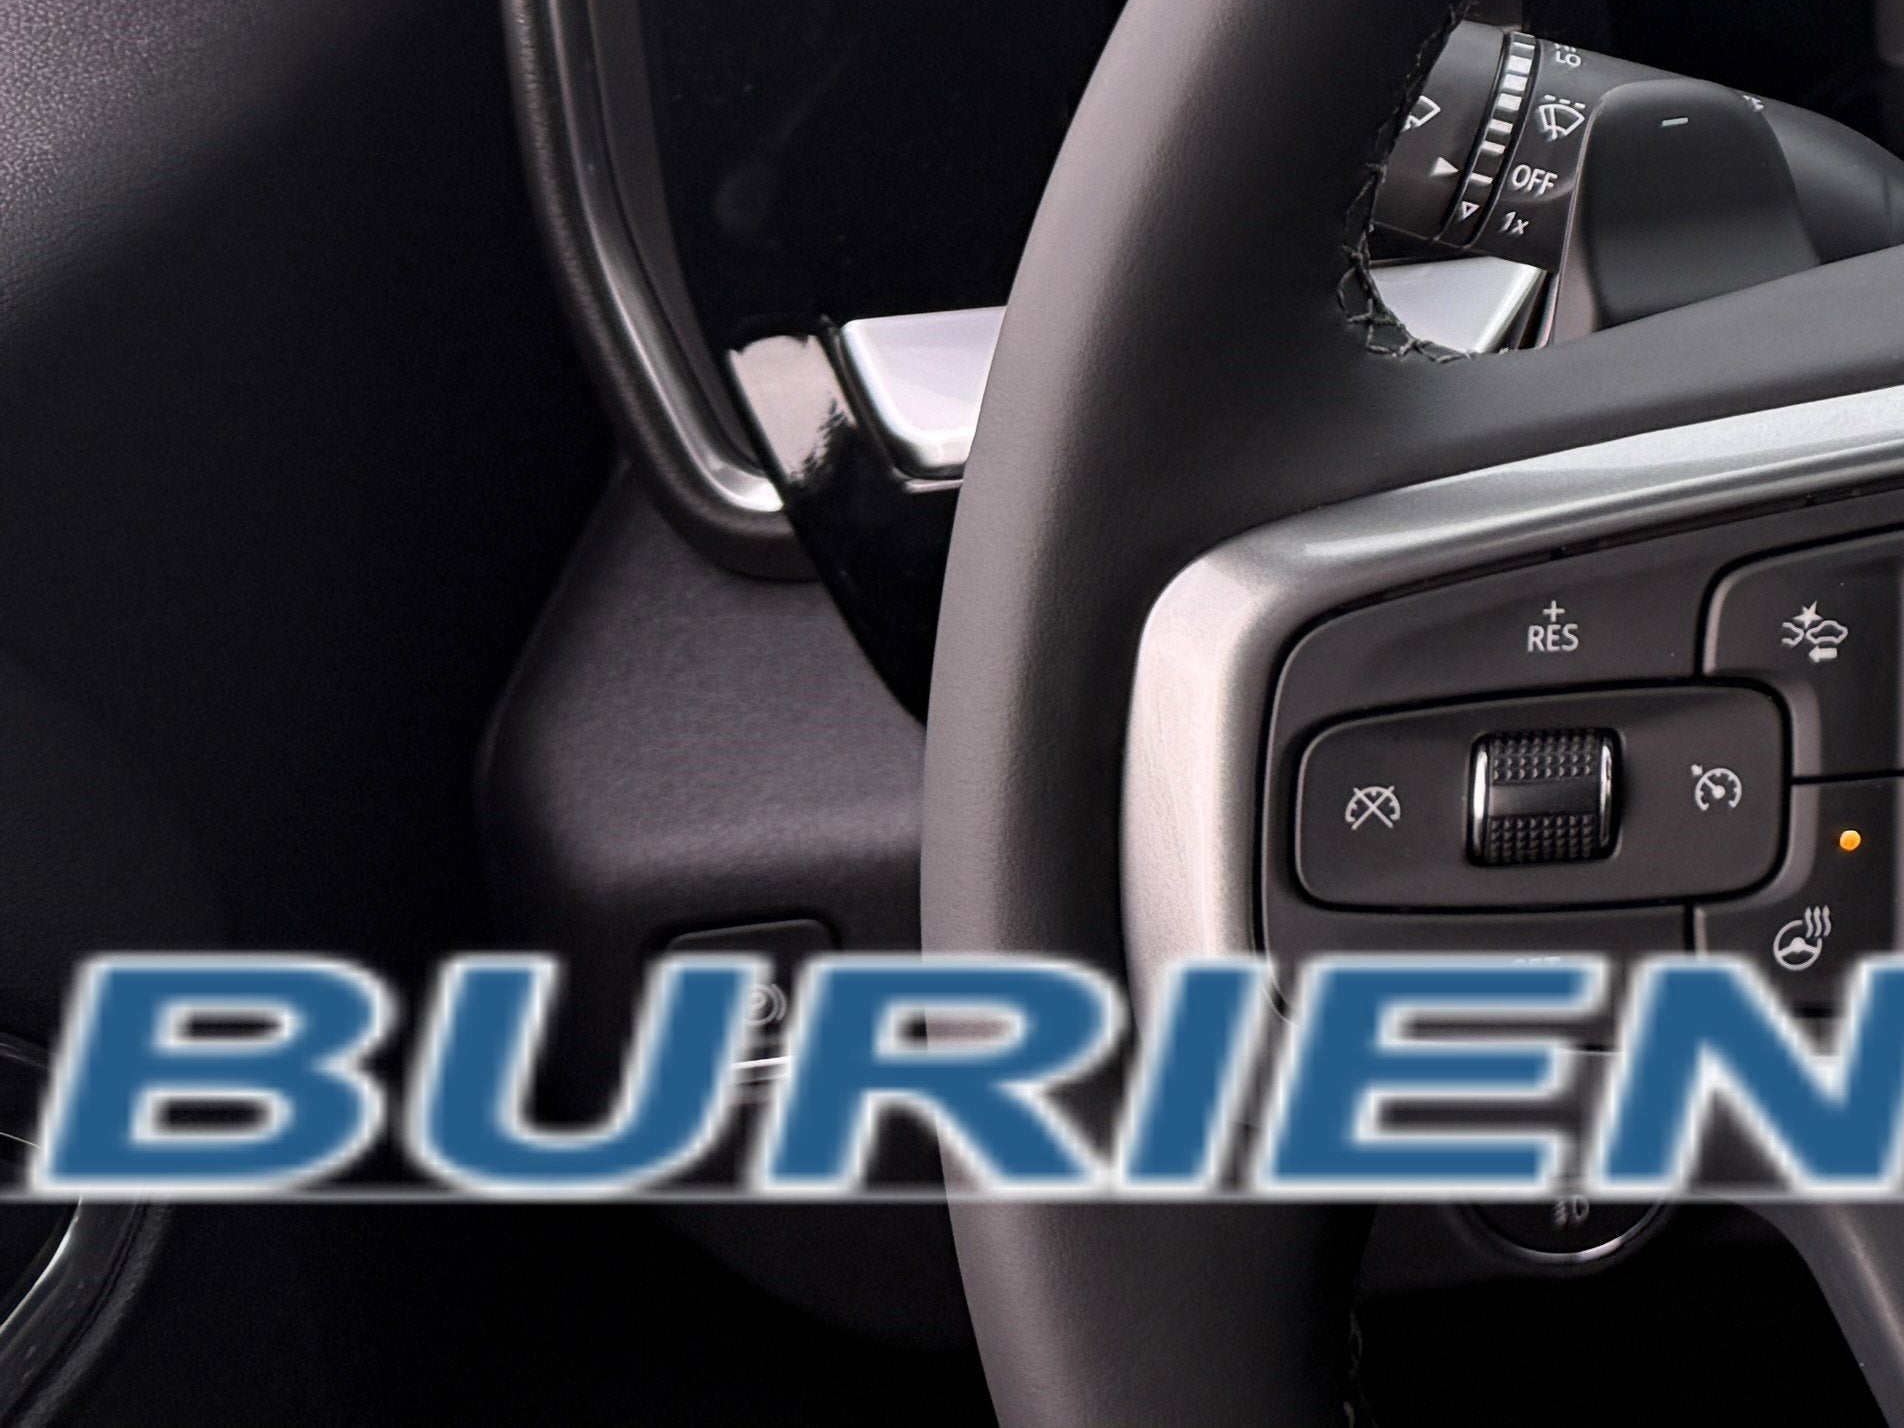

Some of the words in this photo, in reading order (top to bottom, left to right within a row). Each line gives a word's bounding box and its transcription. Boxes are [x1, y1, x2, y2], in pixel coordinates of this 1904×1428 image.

[1555, 50, 1582, 68] LO
[1511, 163, 1559, 195] OFF
[1501, 210, 1530, 235] 1x
[1526, 623, 1580, 653] RES
